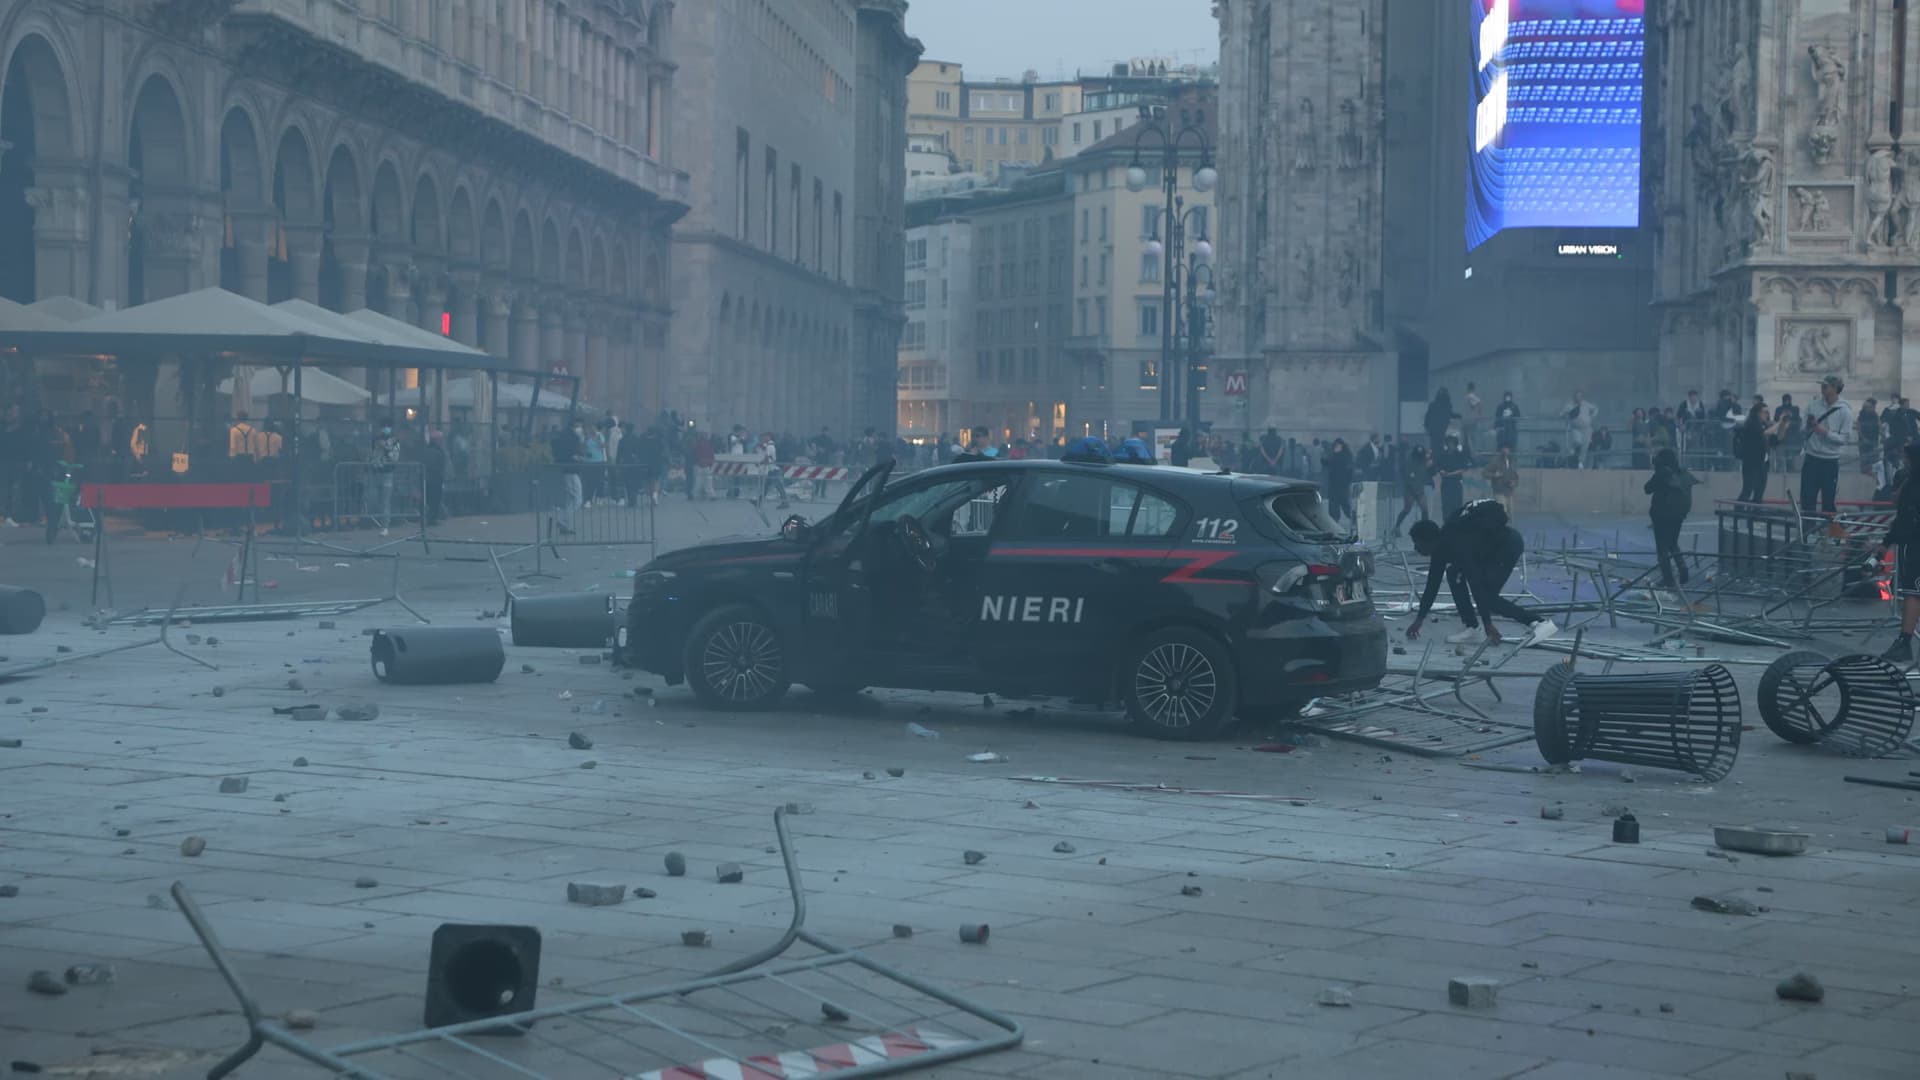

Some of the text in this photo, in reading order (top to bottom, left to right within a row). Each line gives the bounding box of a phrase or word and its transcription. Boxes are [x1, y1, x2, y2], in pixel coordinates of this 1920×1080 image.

[1226, 375, 1245, 392] M
[1196, 517, 1239, 539] 112
[980, 595, 1085, 624] NIERI
